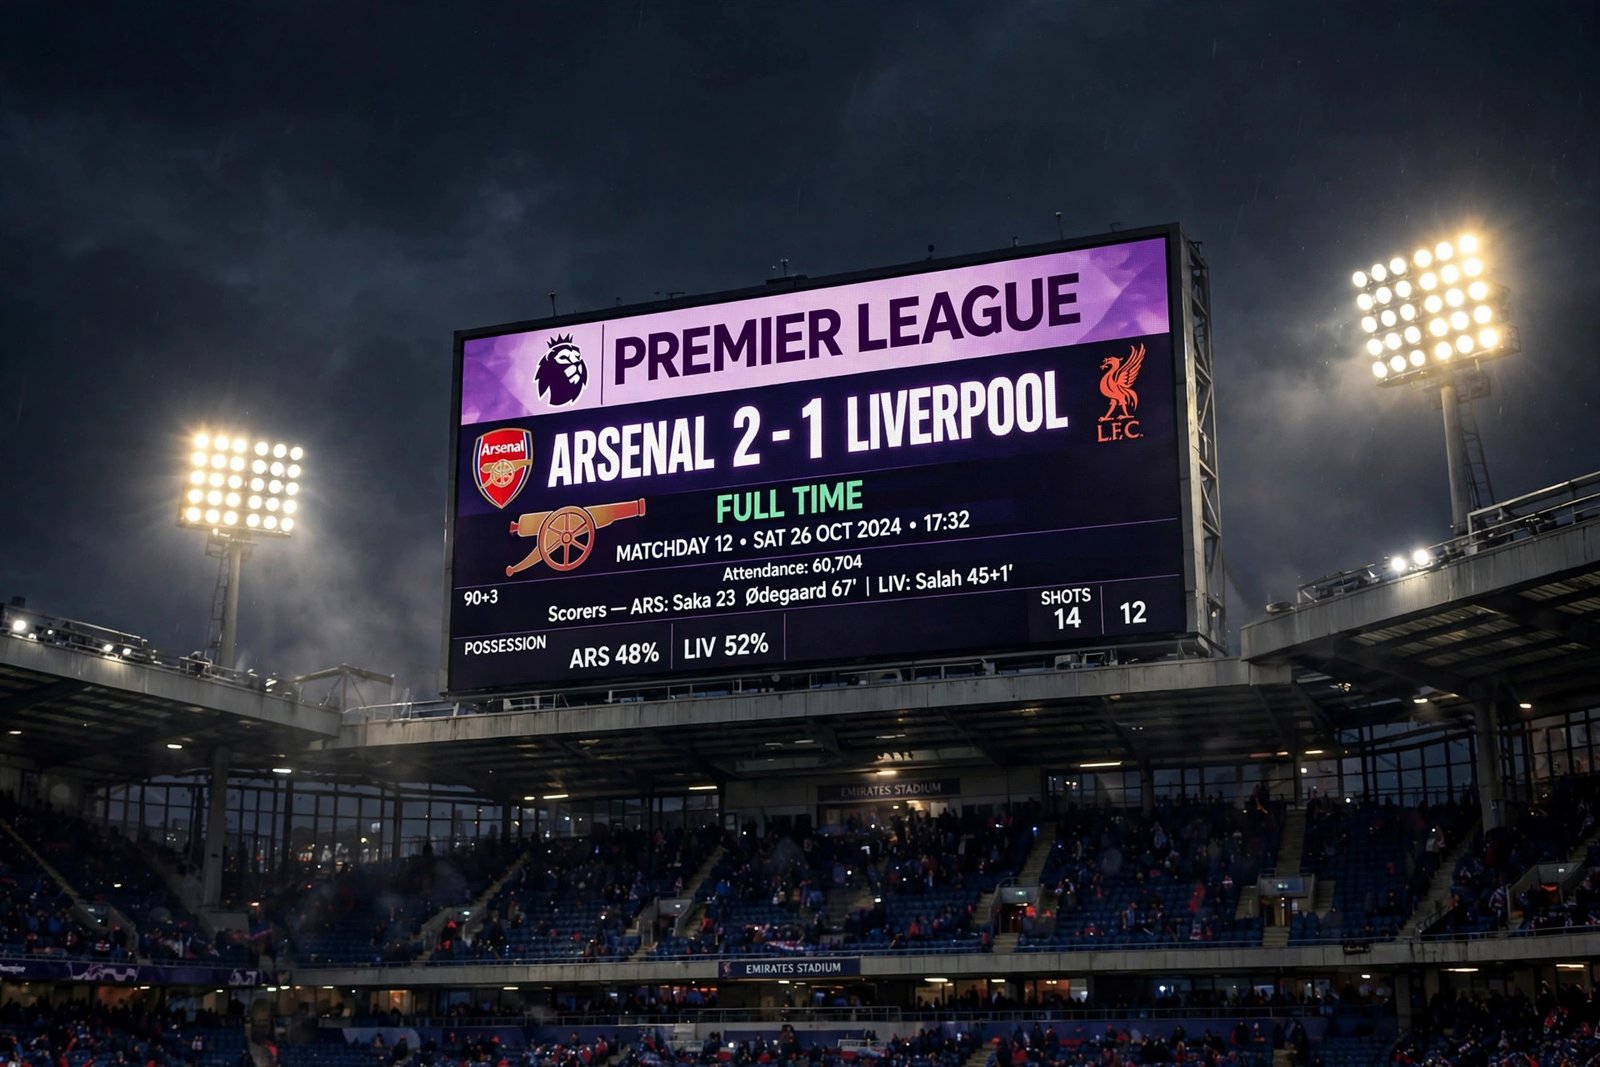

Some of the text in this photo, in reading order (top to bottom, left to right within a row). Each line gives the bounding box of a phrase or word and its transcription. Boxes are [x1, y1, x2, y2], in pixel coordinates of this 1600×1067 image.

[615, 273, 1080, 385] PREMIER LEAGUE
[547, 415, 715, 488] ARSENAL
[732, 405, 761, 468] 2
[801, 397, 823, 460] 1
[847, 370, 1069, 453] LIVERPOOL
[481, 439, 525, 457] Arsenal
[716, 479, 863, 524] FULL TIME
[616, 535, 710, 563] MATCHDAY
[714, 533, 733, 553] 12
[753, 528, 787, 549] SAT
[790, 526, 812, 546] 26
[815, 521, 854, 543] OCT
[857, 516, 902, 539] 2024
[923, 509, 970, 532] 17:32
[722, 553, 863, 582] Attendance: 60,704
[463, 588, 499, 607] 90+3
[547, 605, 607, 623] Scorers
[630, 595, 669, 615] ARS:
[672, 592, 712, 611] Saka
[715, 588, 736, 608] 23
[745, 580, 827, 607] Ødegaard
[878, 573, 911, 594] LIV:
[915, 568, 962, 590] Salah
[1040, 587, 1092, 606] SHOTS
[1054, 600, 1147, 630] 14 12
[464, 634, 547, 656] POSSESSION
[569, 641, 660, 669] ARS 48%
[684, 631, 769, 660] LIV 52%
[841, 783, 941, 797] EMIRATES STADIUM
[746, 962, 841, 974] EMIRATES STADIUM
